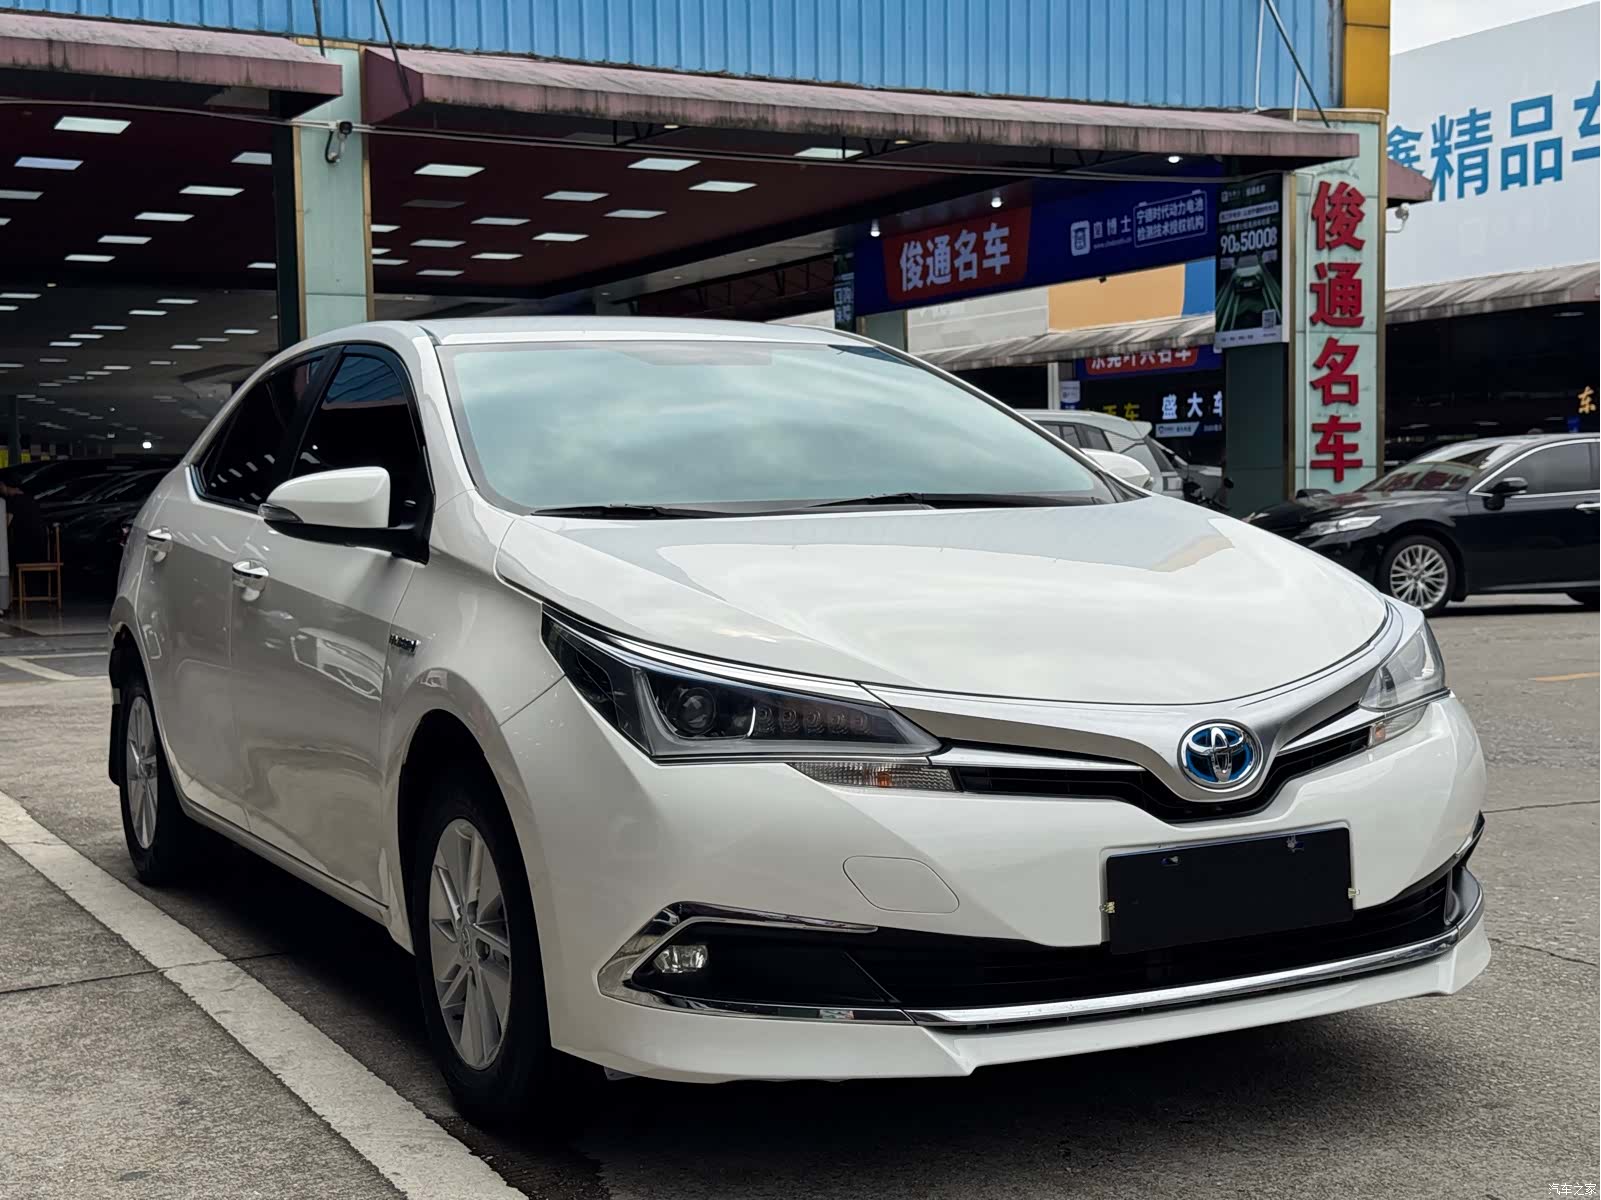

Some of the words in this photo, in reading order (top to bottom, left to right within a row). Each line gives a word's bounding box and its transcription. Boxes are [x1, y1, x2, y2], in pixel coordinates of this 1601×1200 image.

[900, 223, 1010, 292] 俊通名车
[1310, 180, 1366, 482] 俊通名车
